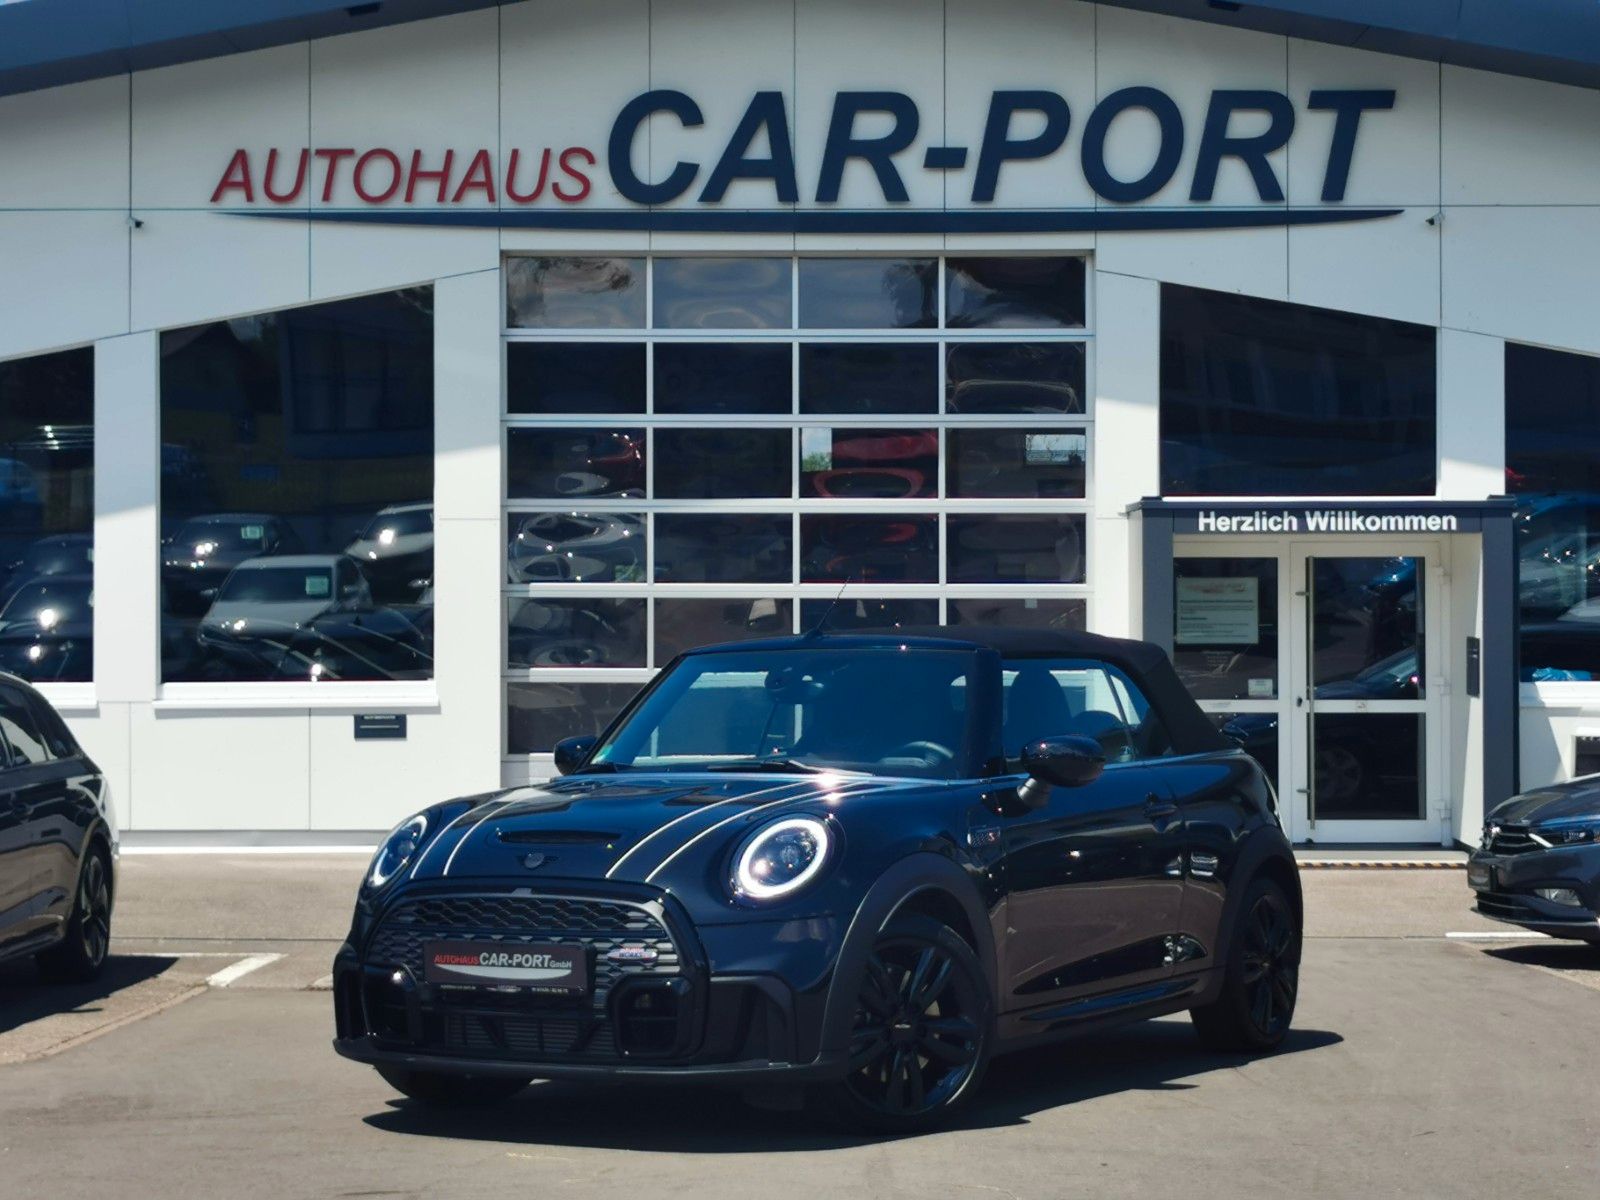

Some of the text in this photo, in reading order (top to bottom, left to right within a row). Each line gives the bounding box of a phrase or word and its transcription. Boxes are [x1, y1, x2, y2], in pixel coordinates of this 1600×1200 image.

[209, 86, 1396, 205] AUTOHAUS CAR-PORT
[1198, 510, 1458, 532] Herzlich Willkommen
[434, 954, 480, 965] AUTOHAUS
[479, 952, 551, 968] CAR-PORT
